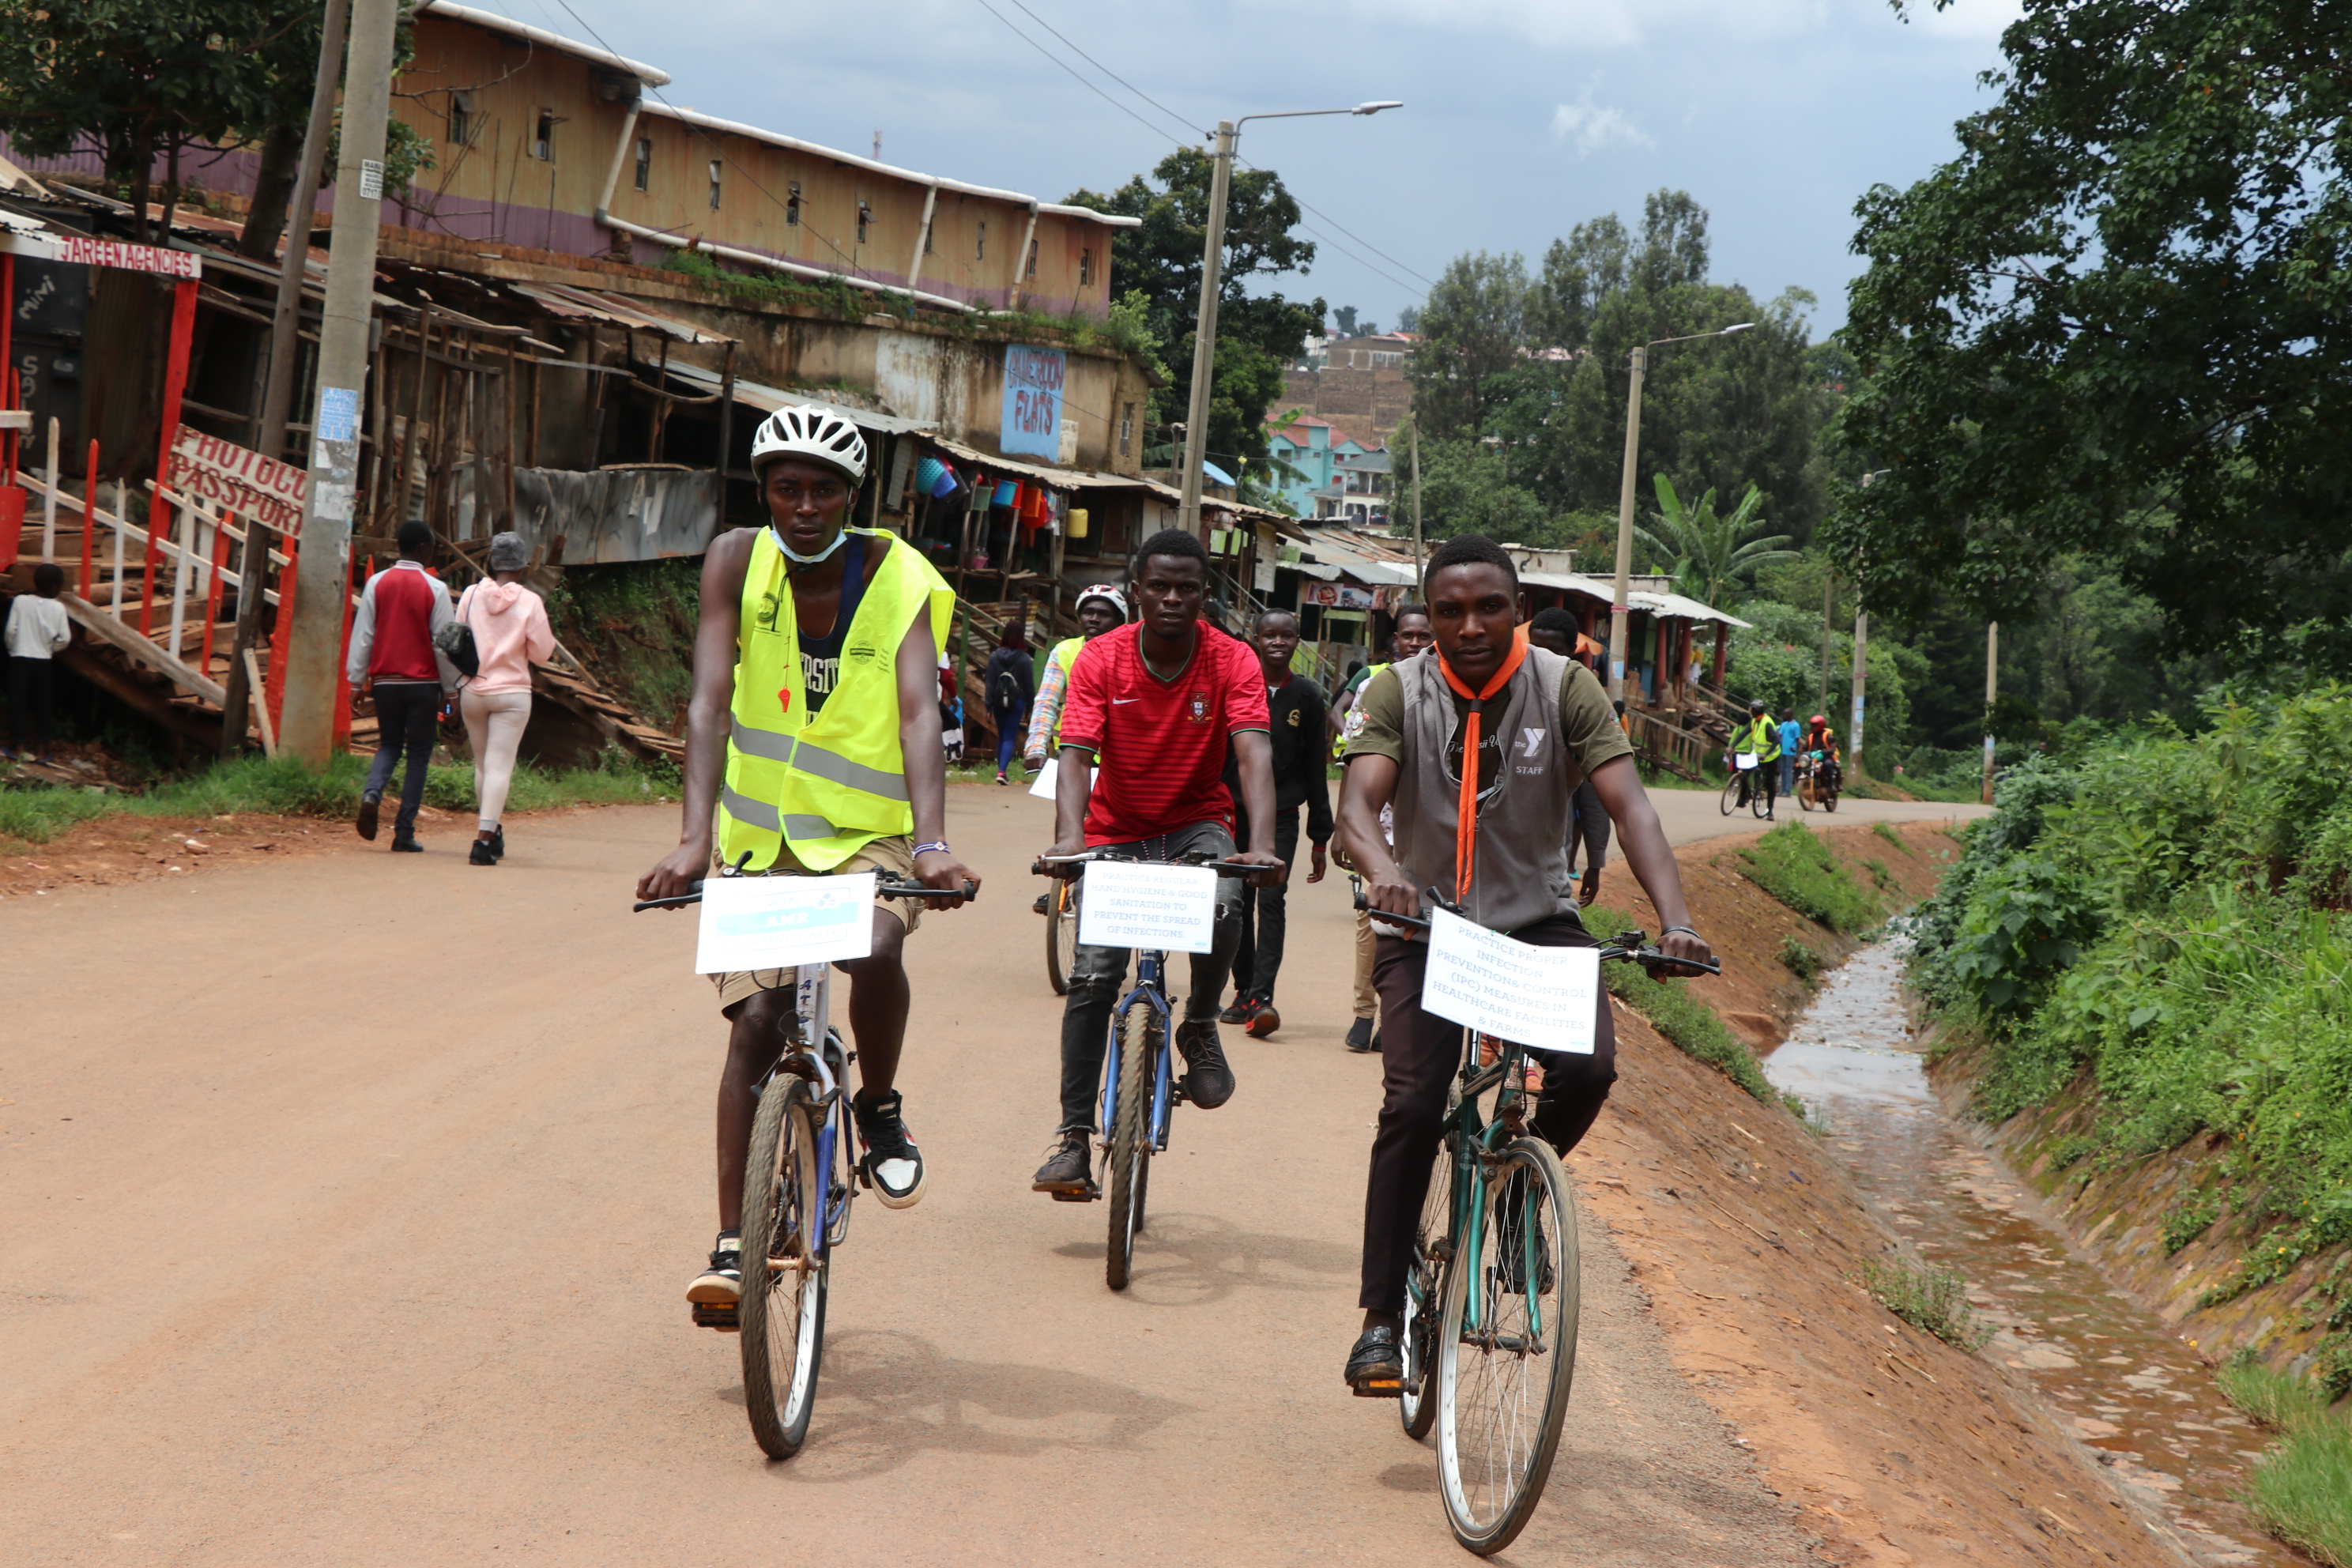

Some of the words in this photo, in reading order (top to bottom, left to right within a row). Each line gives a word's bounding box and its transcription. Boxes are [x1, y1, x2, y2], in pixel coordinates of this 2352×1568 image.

[61, 236, 122, 268] JAREEN
[126, 244, 192, 277] AGENCIES
[1015, 390, 1054, 436] FLATS
[1516, 766, 1544, 775] STAFF
[1102, 873, 1151, 882] PRACTICE
[1153, 876, 1198, 885] REGULAR
[767, 895, 809, 906] WORLD
[1122, 886, 1167, 896] HYGIENE
[1178, 890, 1208, 899] GOOD
[1110, 898, 1171, 910] SANITATION
[1173, 903, 1187, 911] TO
[764, 912, 810, 928] AMR
[1094, 910, 1139, 922] PREVENT
[1141, 914, 1160, 923] THE
[1163, 916, 1201, 925] SPREAD
[733, 933, 804, 947] AWARENESS
[808, 929, 839, 940] WEEK
[1123, 926, 1185, 938] INFECTIONS.
[1457, 925, 1515, 956] PRACTICE
[1518, 950, 1568, 965] PROPER
[1476, 949, 1544, 978] INFECTION
[1451, 971, 1481, 992] (IPC)
[1483, 985, 1549, 1010] MEASURES
[1553, 1003, 1567, 1012] IN
[1523, 983, 1587, 998] CONTROL
[1432, 980, 1512, 1017] HEALTHCARE
[1514, 1012, 1585, 1030] FACILITIES
[1478, 1016, 1487, 1025] &
[1489, 1020, 1531, 1038] FARMS
